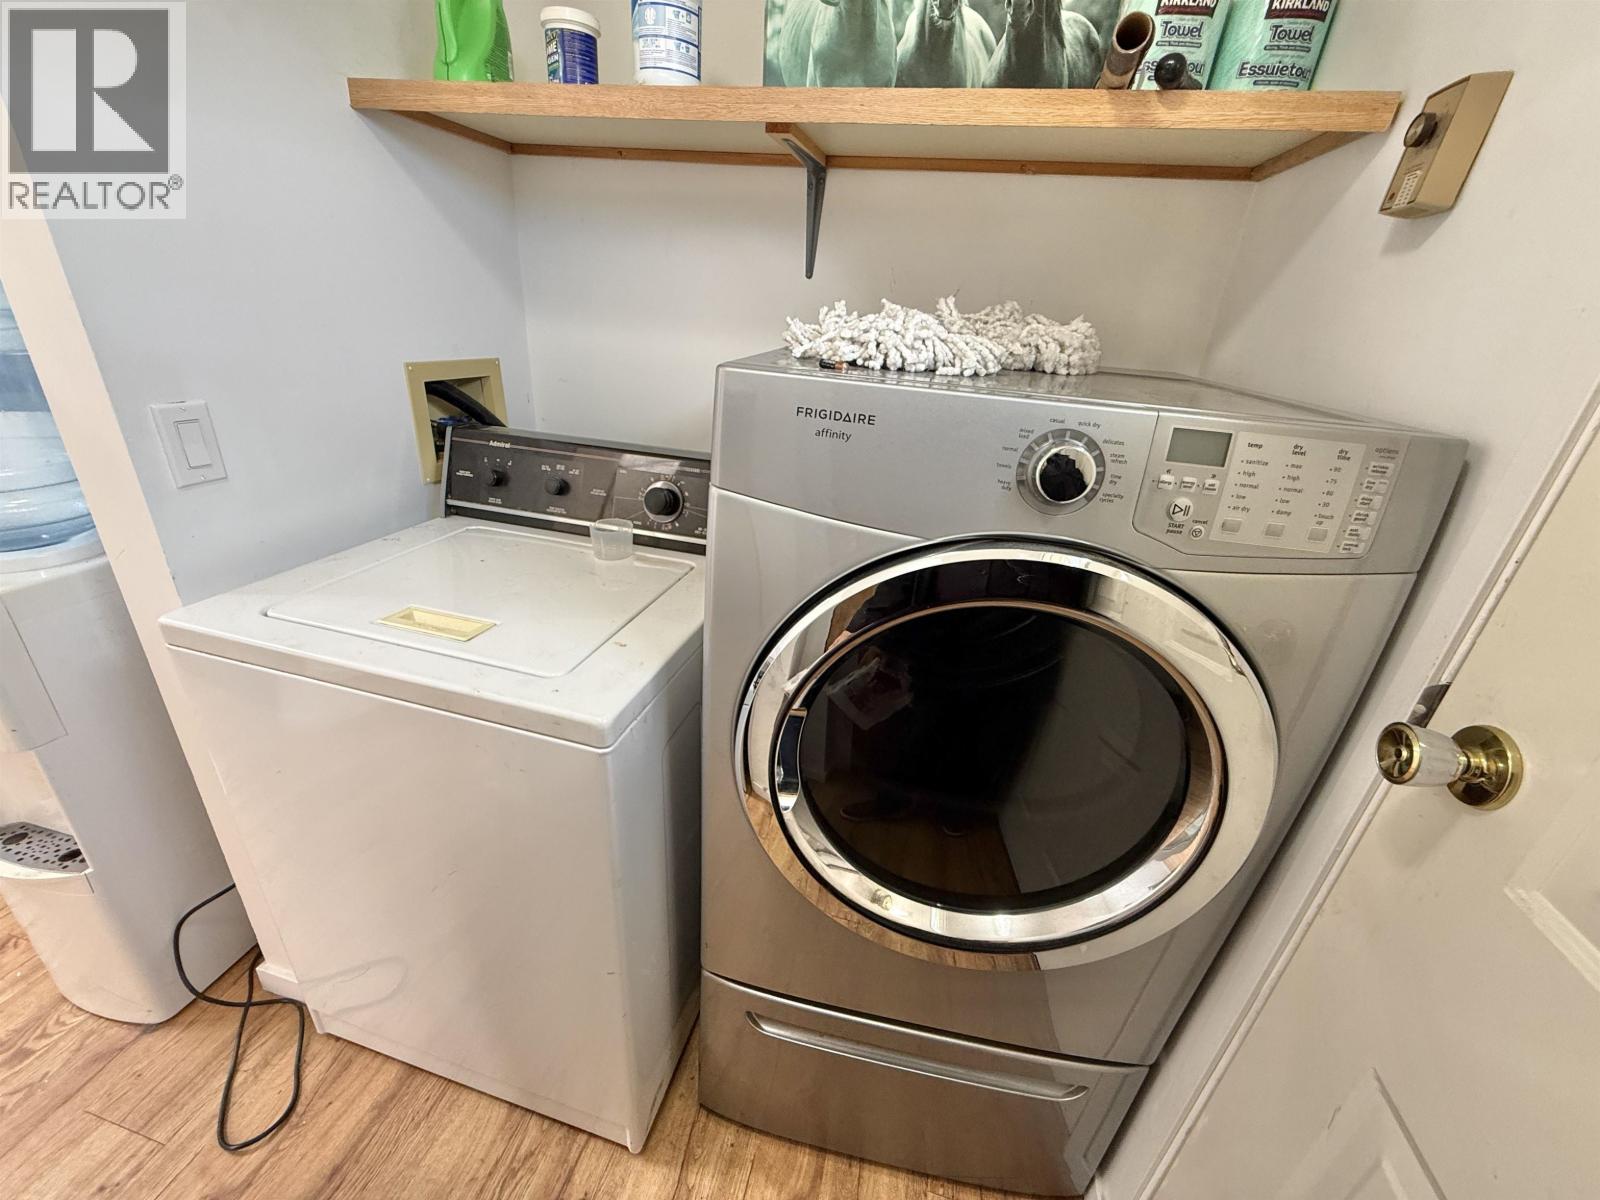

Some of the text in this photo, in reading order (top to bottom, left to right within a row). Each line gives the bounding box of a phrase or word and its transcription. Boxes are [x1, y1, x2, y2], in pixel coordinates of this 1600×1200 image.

[1272, 0, 1329, 12] KIRKLAND
[1162, 20, 1204, 38] Towel
[1271, 24, 1315, 42] Towel
[796, 406, 876, 426] FRIGIDAIRE
[1092, 421, 1101, 429] dry
[815, 428, 852, 443] affinity
[1242, 470, 1256, 478] high
